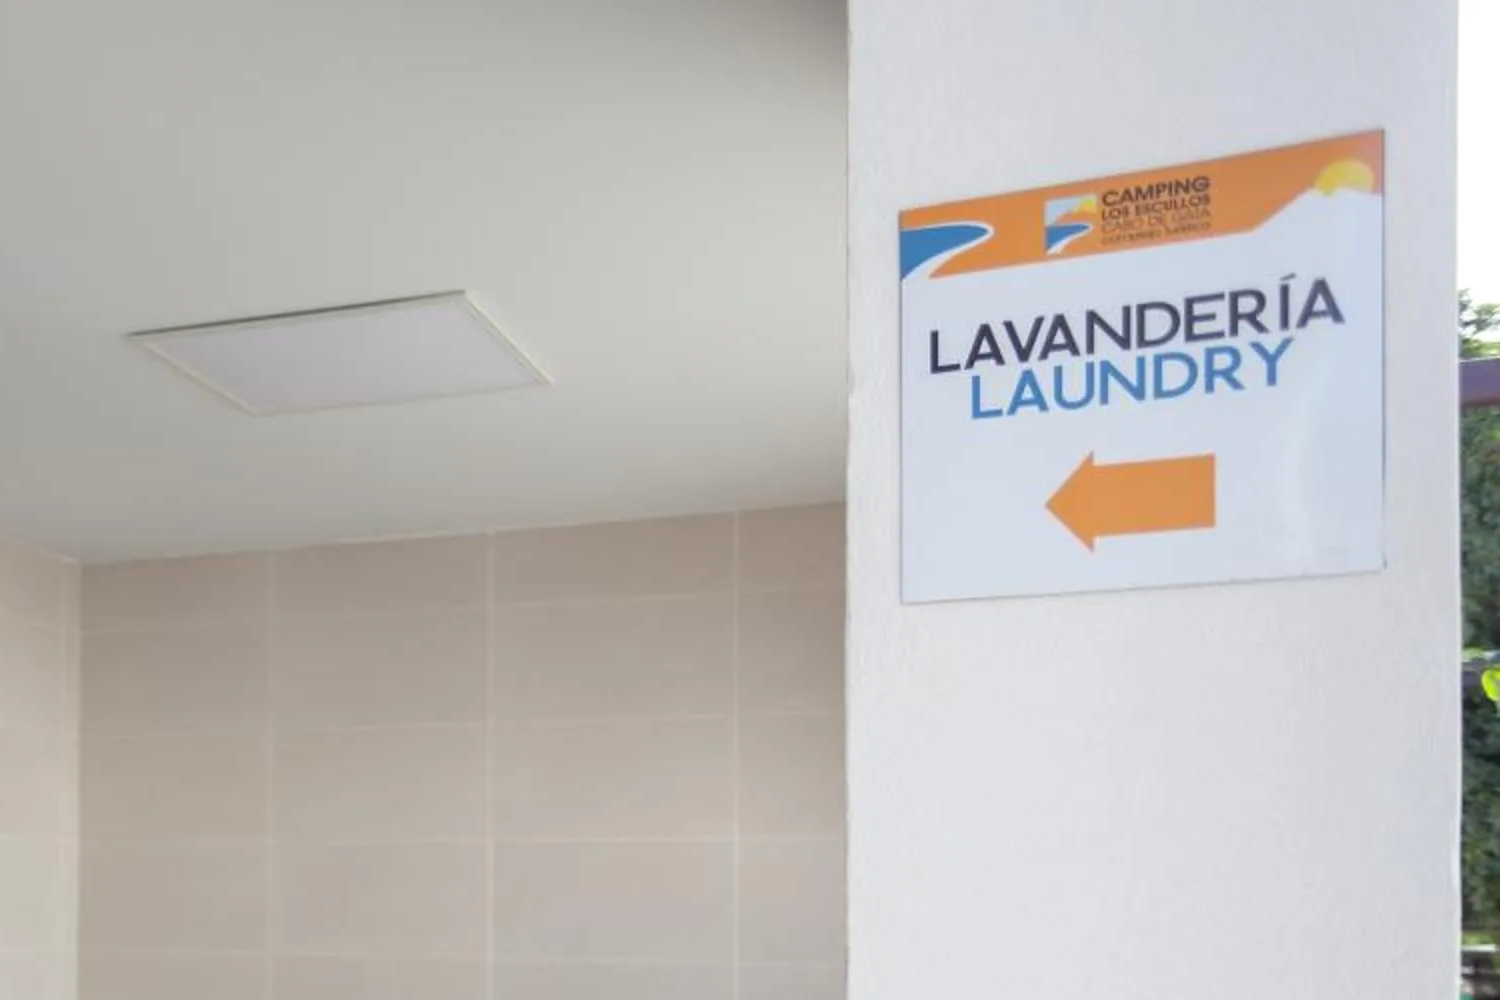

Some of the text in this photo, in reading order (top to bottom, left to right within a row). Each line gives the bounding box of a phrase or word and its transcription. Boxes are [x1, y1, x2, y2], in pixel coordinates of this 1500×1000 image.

[1101, 206, 1130, 222] LOS
[1102, 176, 1210, 207] CAMPING
[929, 273, 1346, 375] LAVANDERÍA
[971, 336, 1297, 421] LAUNDRY
